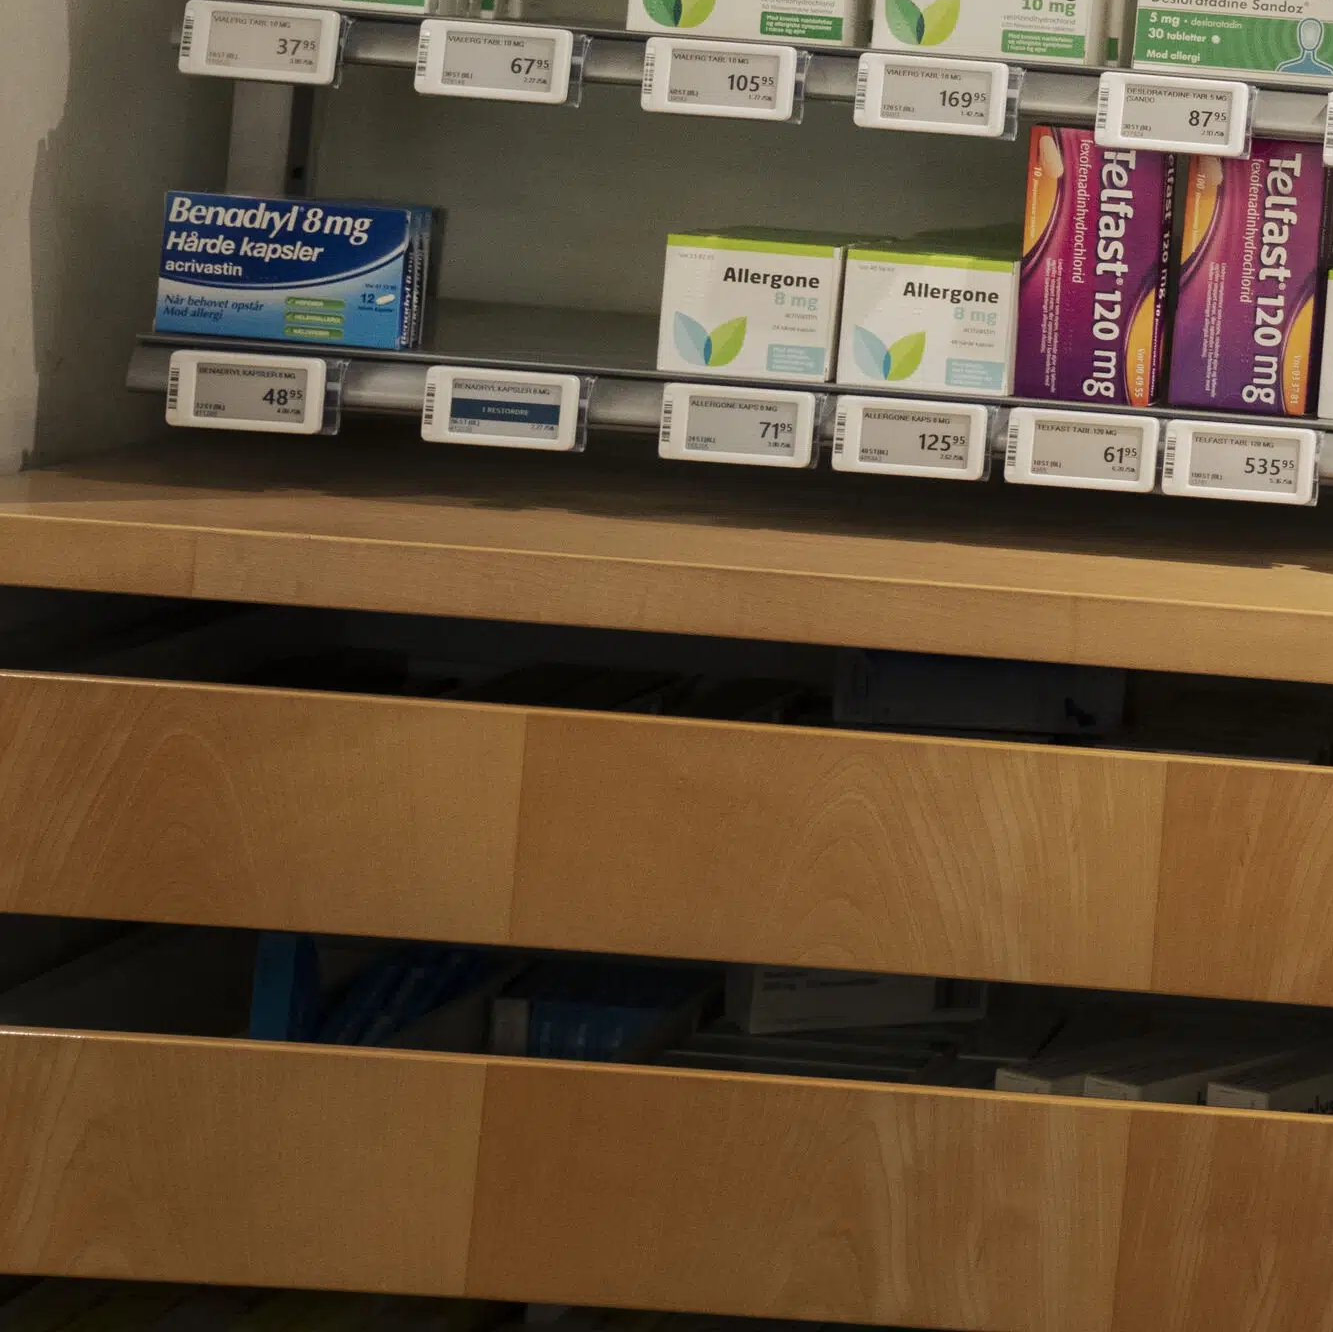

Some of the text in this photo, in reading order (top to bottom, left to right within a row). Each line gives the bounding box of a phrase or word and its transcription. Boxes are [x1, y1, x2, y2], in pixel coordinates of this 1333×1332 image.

[169, 197, 299, 234] Benadryl
[166, 231, 323, 262] Hårde kapsler
[165, 259, 242, 277] acrivastin
[903, 281, 999, 304] Allergone
[1082, 291, 1121, 398] 120 mg
